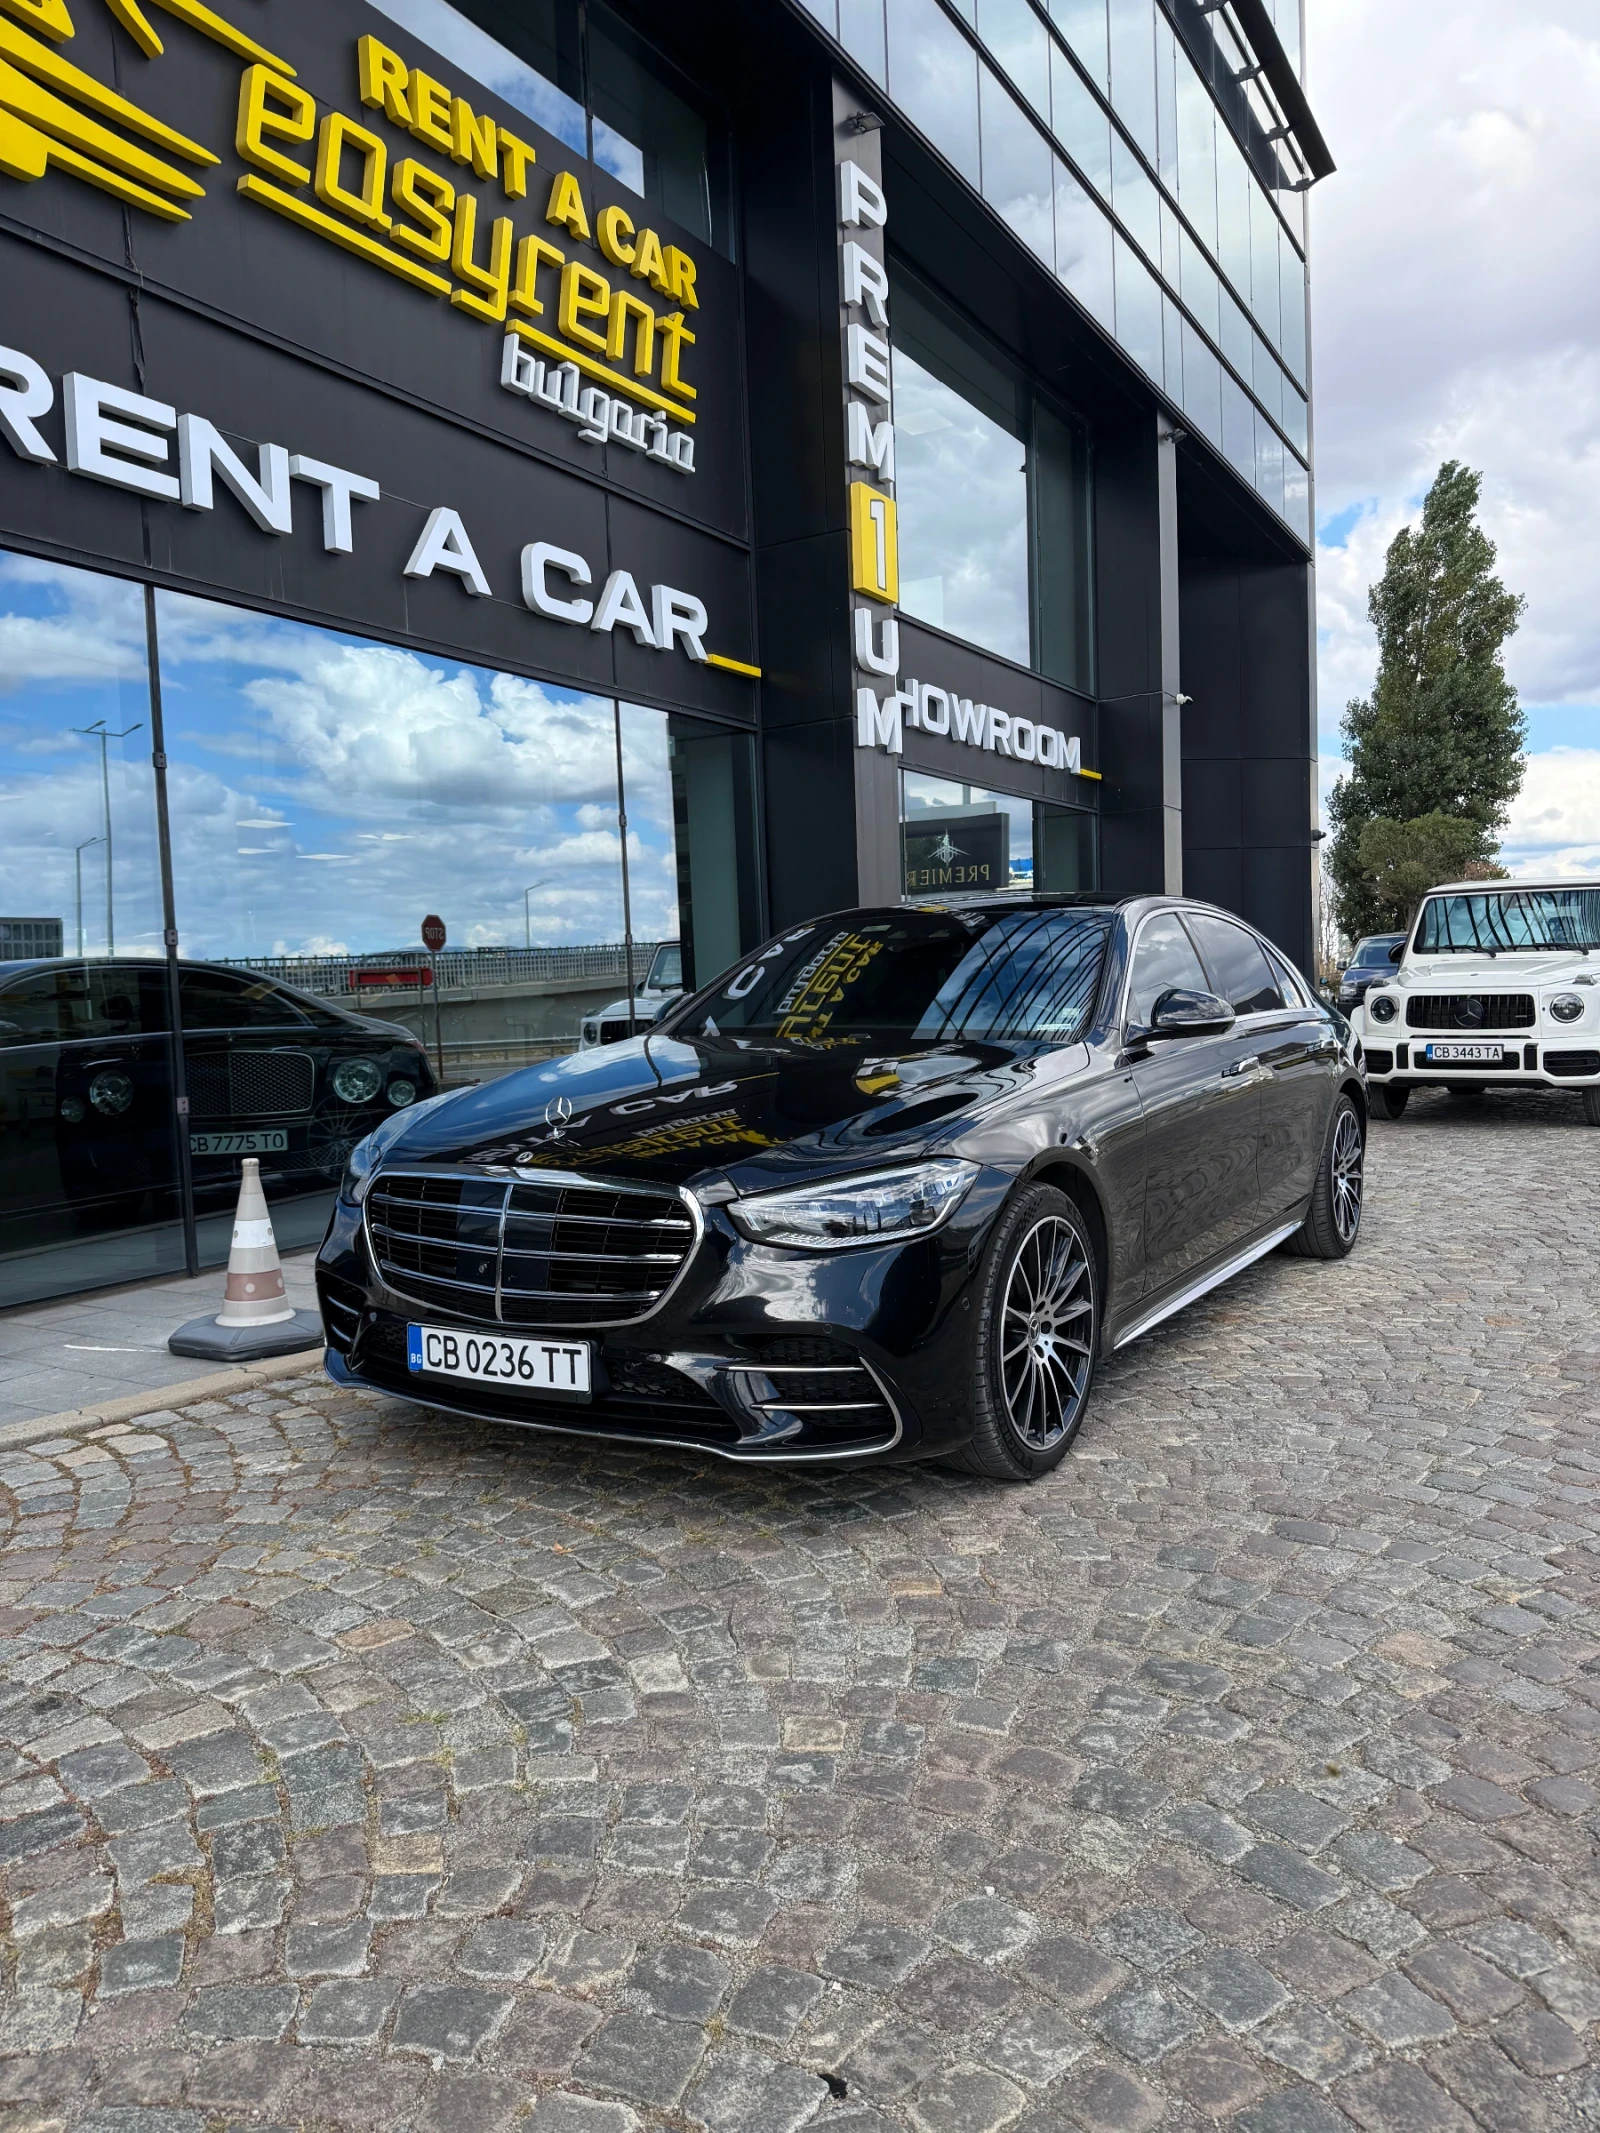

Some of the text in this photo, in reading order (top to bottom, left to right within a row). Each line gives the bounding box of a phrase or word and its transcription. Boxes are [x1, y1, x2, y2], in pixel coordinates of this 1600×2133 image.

[236, 64, 697, 399] easyrent
[358, 34, 699, 311] RENT A CAR
[501, 333, 696, 474] bulgaria
[0, 345, 709, 662] RENT A CAR
[896, 679, 1081, 774] HOWROOM
[1434, 1047, 1450, 1058] CB
[1452, 1047, 1481, 1058] 3443
[1484, 1047, 1500, 1058] TA
[212, 1134, 257, 1152] 7775
[261, 1133, 284, 1149] TO
[410, 1333, 582, 1385] BG CB 0236 TT
